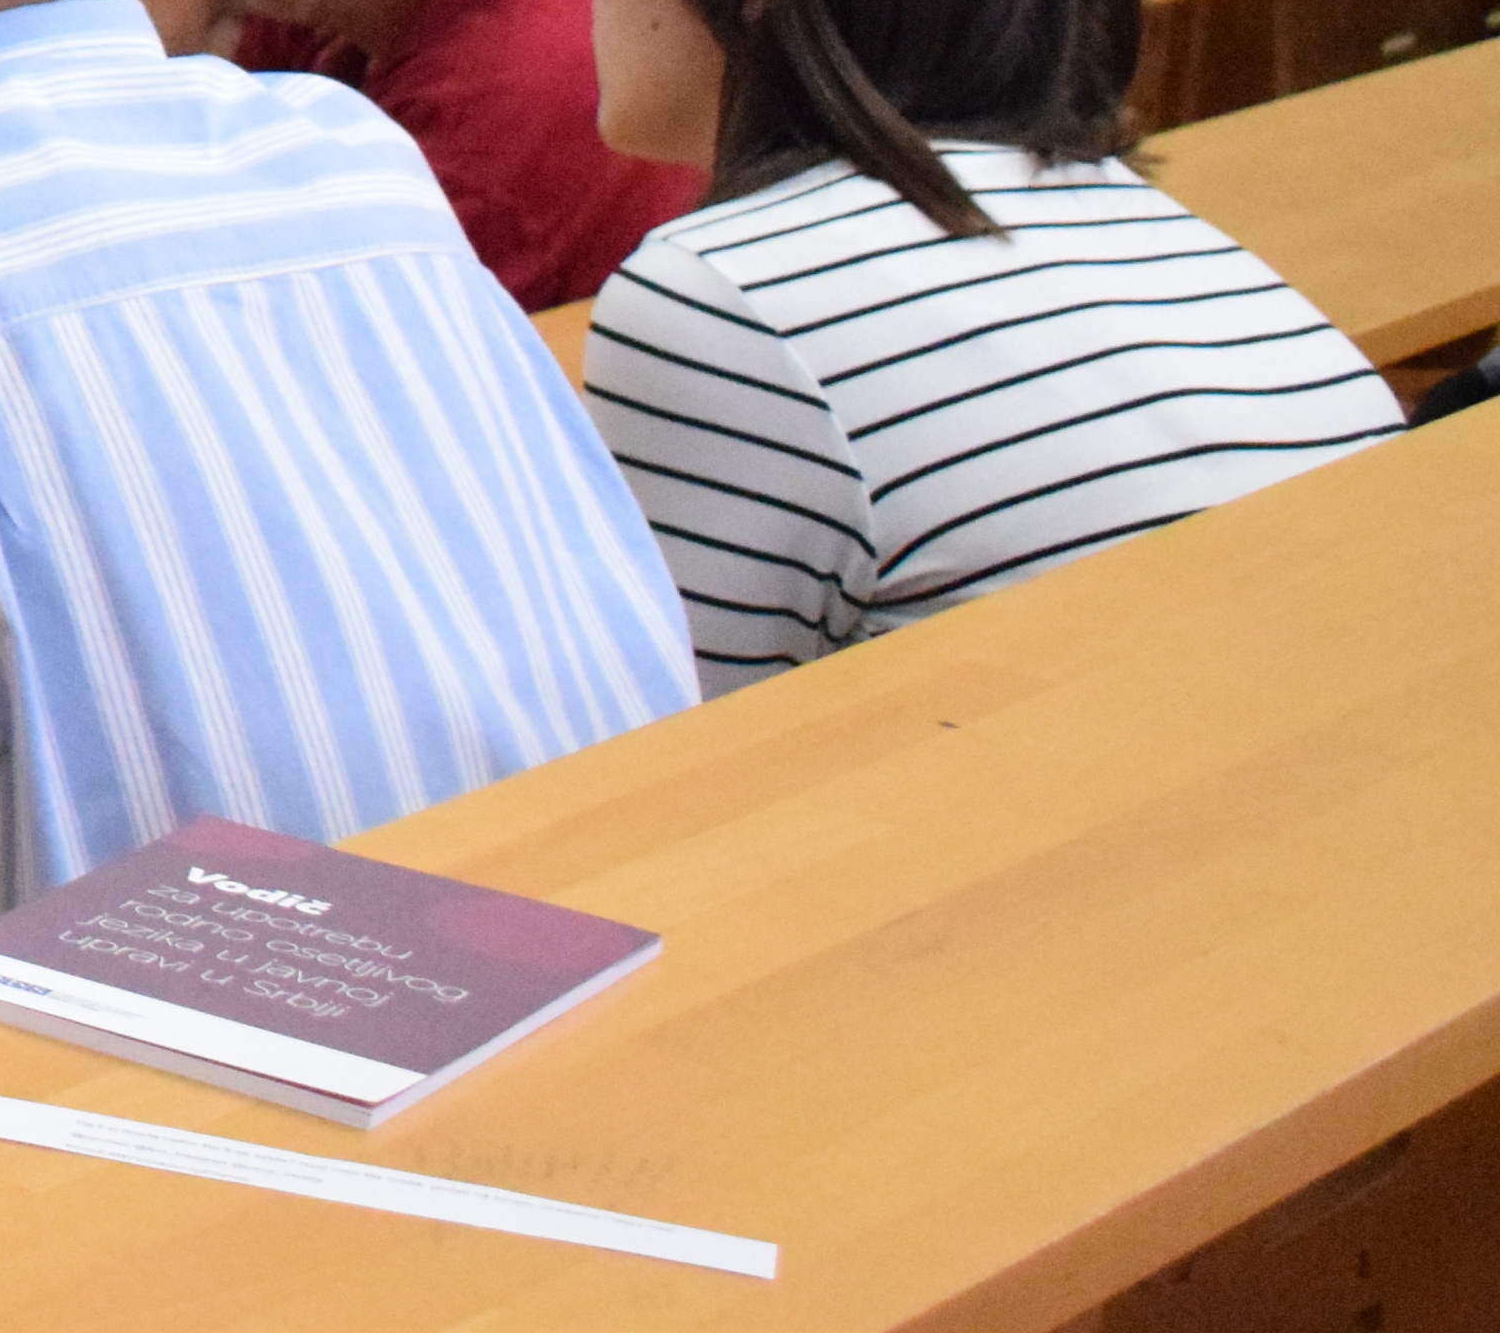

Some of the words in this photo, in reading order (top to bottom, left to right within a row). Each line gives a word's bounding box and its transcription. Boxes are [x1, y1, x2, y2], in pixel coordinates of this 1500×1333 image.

[147, 884, 200, 905] za
[211, 901, 413, 960] upotrebu
[187, 866, 334, 915] Vodič
[58, 930, 195, 973] upravi
[201, 969, 234, 986] u
[243, 979, 351, 1018] Srbiji
[77, 912, 205, 954] jezika
[216, 949, 249, 964] u
[250, 958, 395, 1008] javnoj
[119, 898, 254, 942] rodno
[266, 939, 469, 1003] osetljivog
